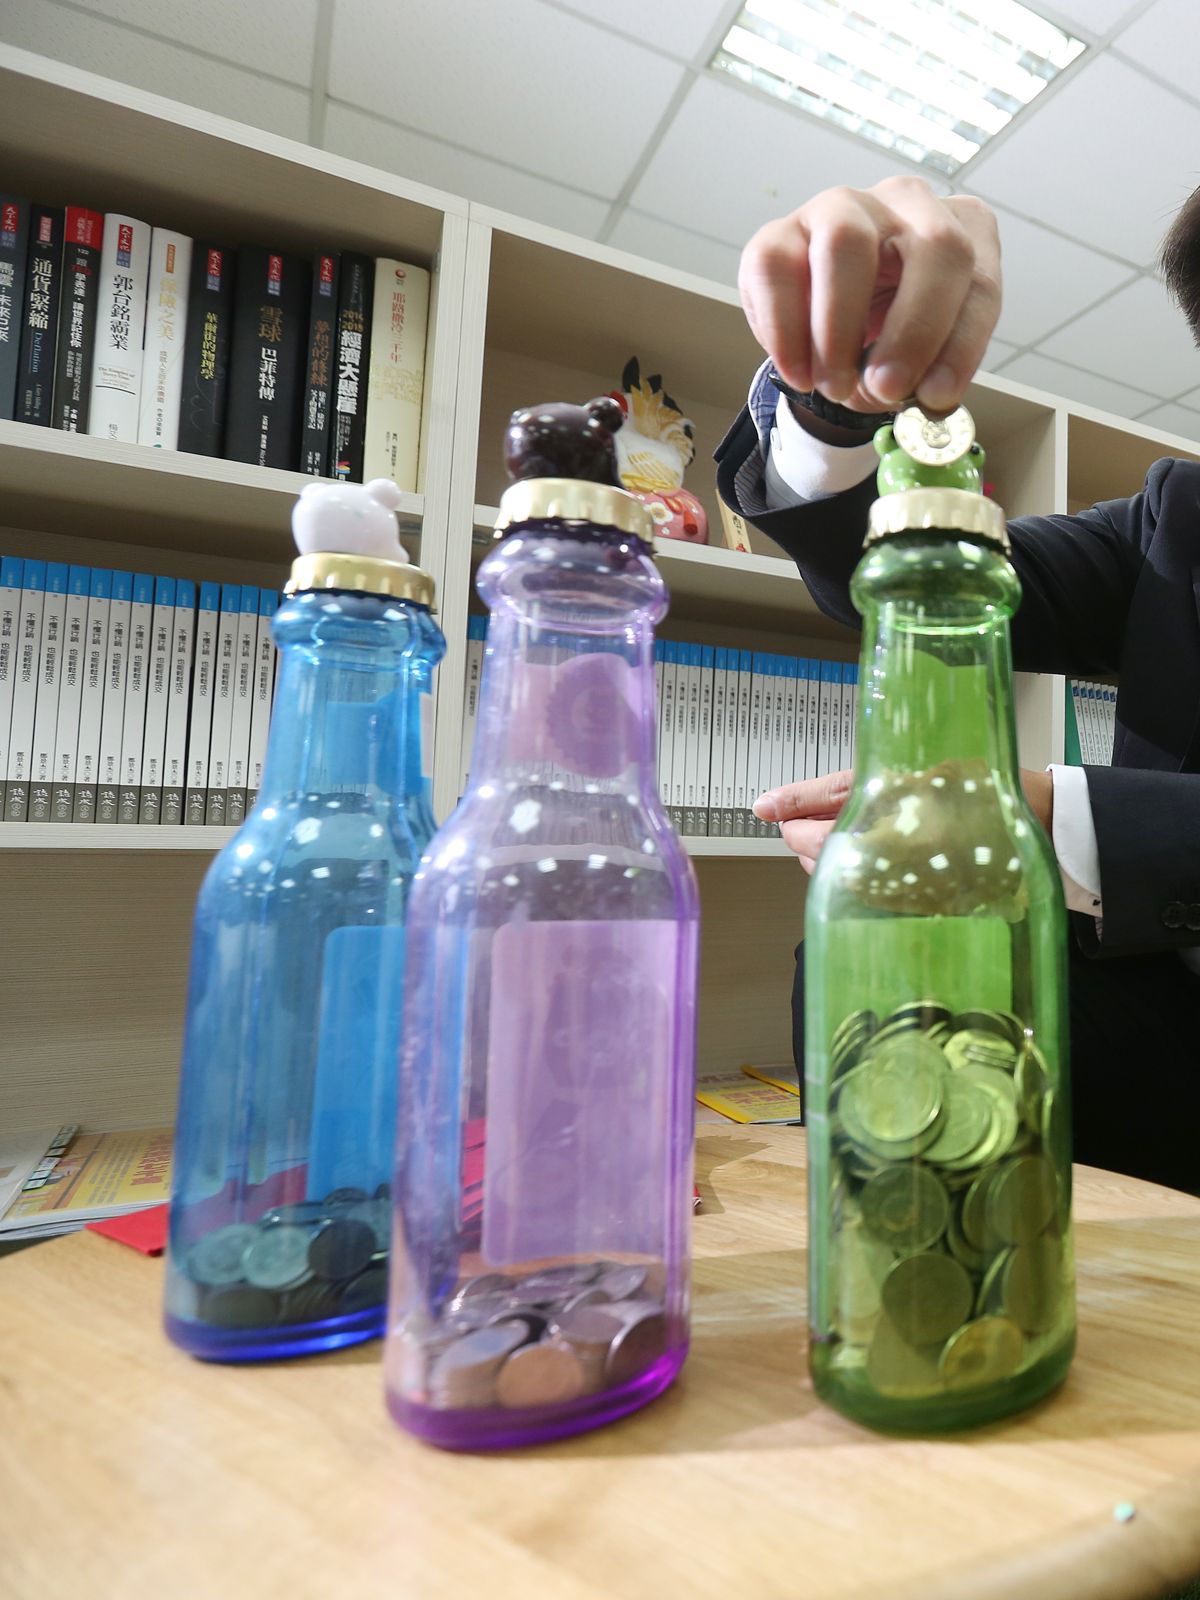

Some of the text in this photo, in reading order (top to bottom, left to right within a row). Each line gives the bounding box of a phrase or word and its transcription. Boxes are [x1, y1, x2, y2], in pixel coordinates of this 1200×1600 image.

[29, 257, 52, 329] 通貨緊縮
[109, 274, 133, 351] 郭台銘霸業
[259, 305, 283, 342] 雪球
[390, 291, 405, 363] 耶路撒冷三千年
[259, 347, 278, 401] 巴菲特傳
[336, 330, 363, 415] 經濟大懸崖
